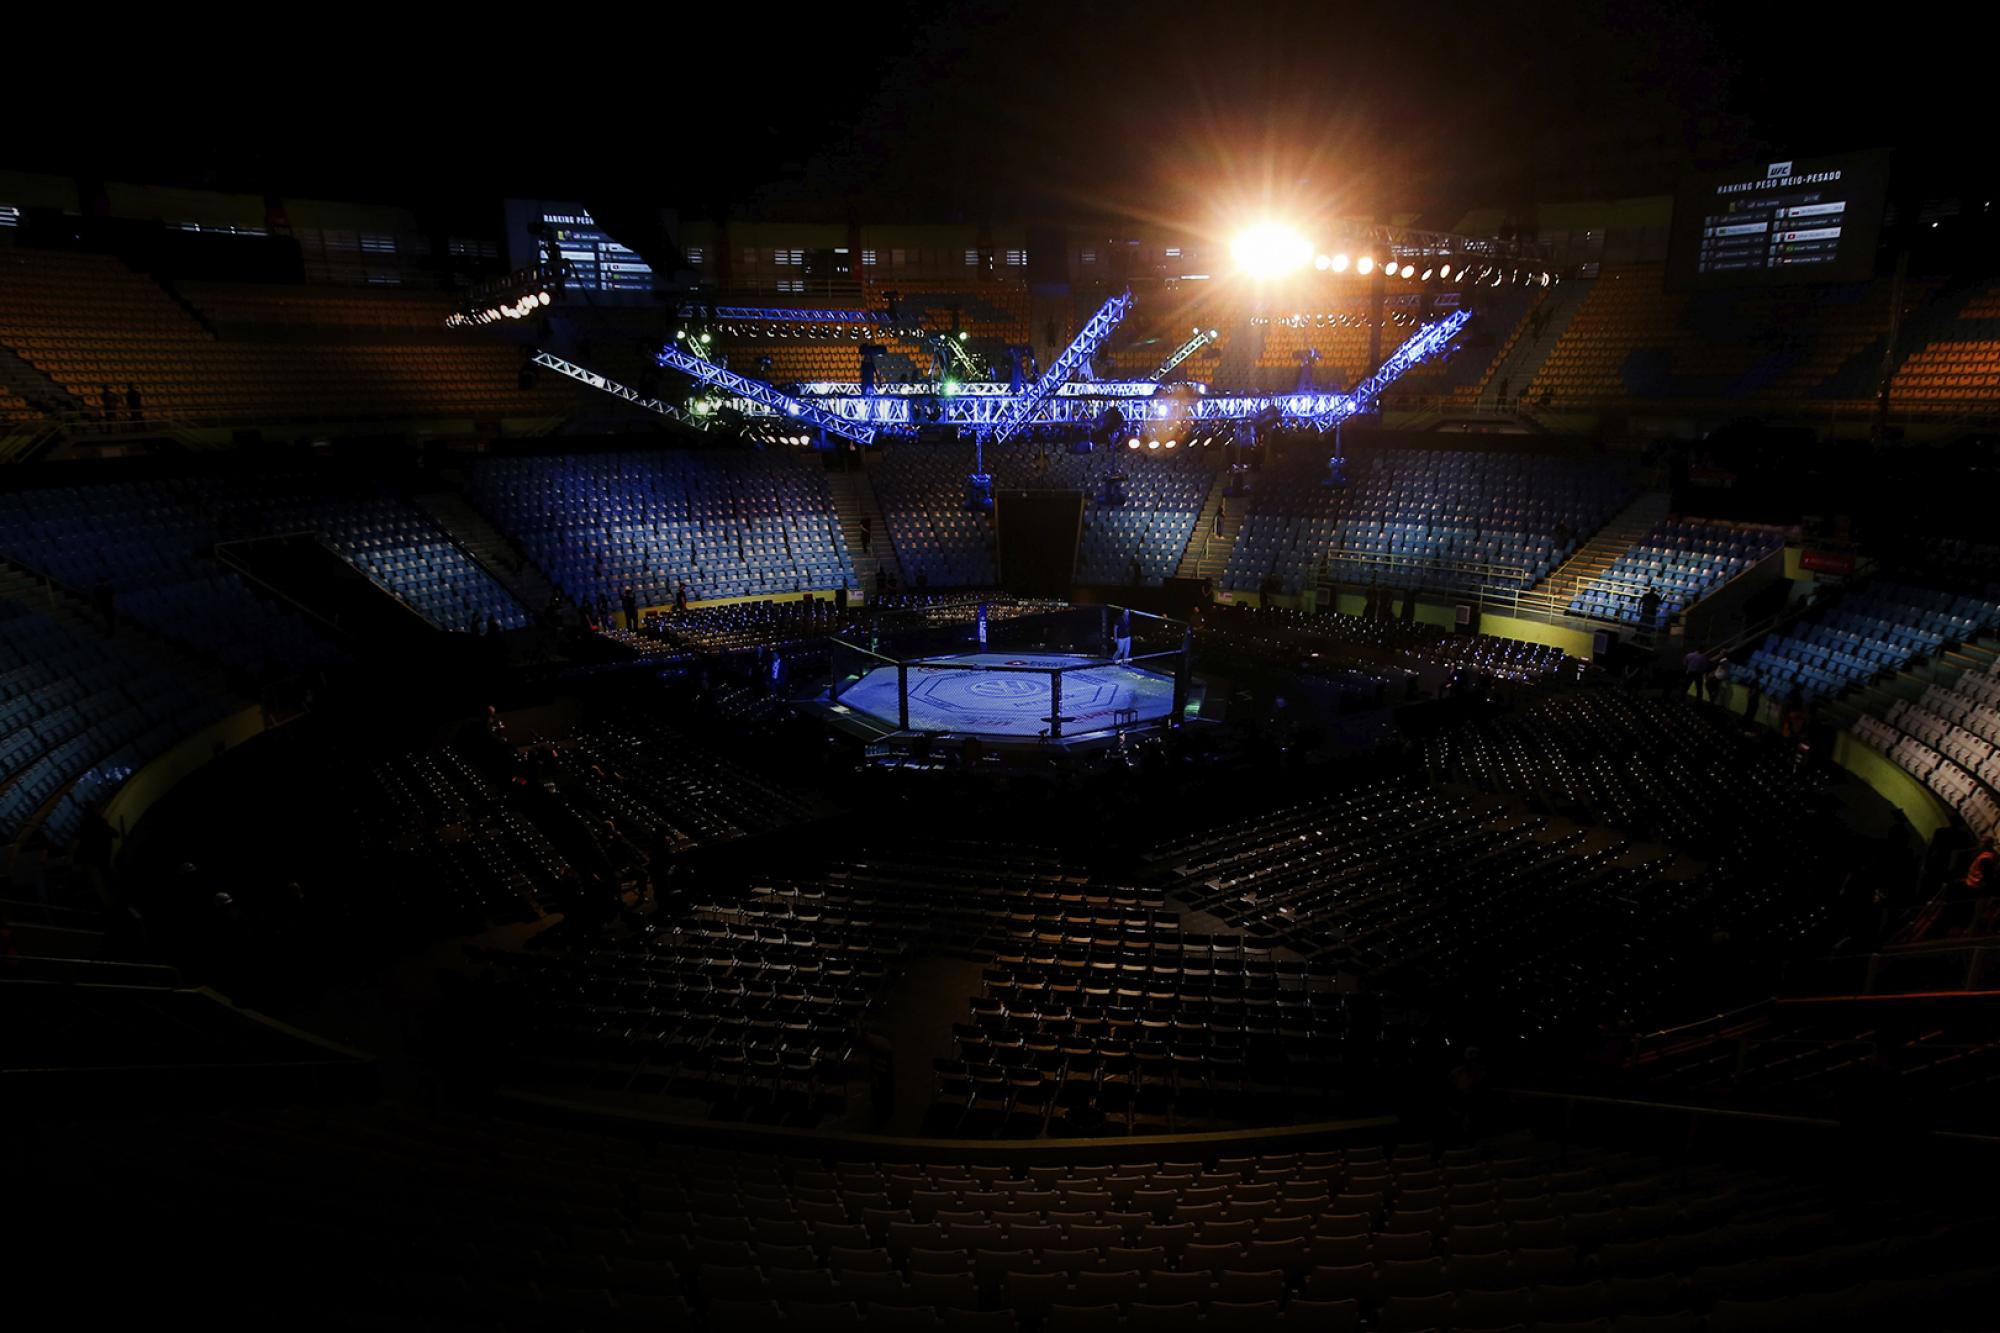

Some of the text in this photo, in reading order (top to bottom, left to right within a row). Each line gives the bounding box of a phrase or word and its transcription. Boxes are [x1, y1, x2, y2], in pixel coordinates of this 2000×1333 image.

[1769, 164, 1790, 177] UFC
[1716, 170, 1842, 194] RANKING PESO MEIO-PESADO
[543, 214, 575, 224] RANKING
